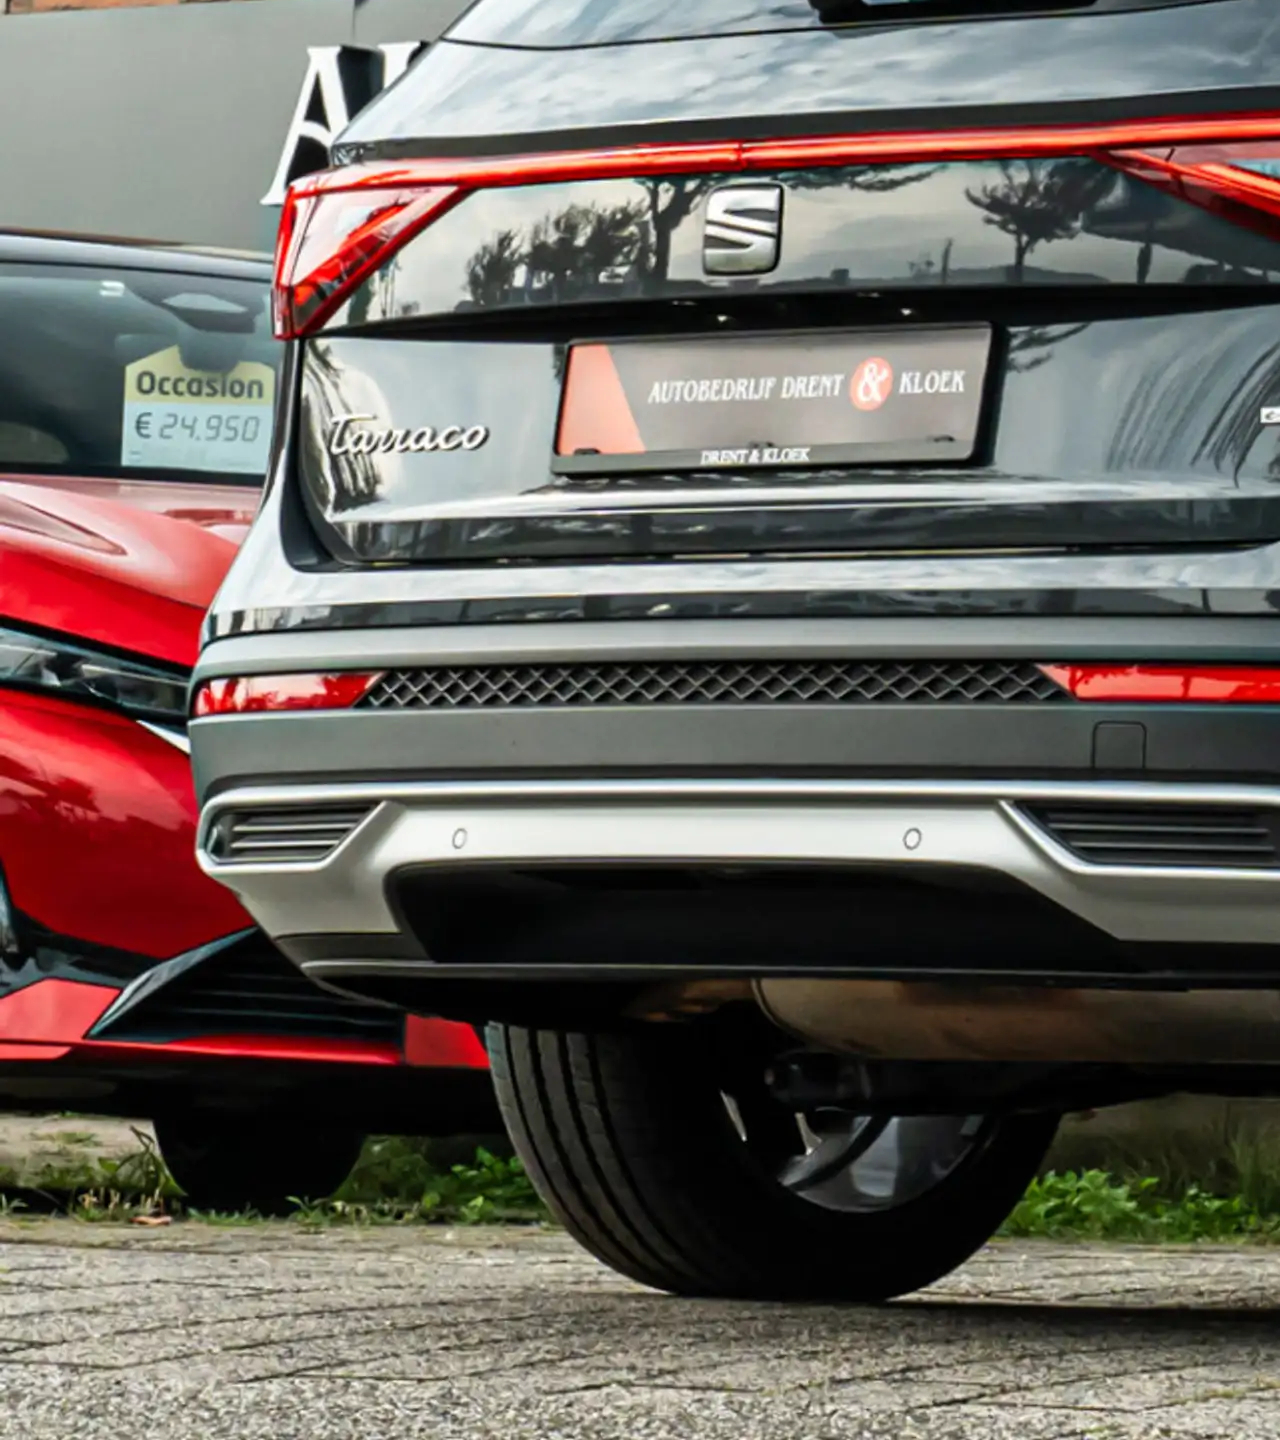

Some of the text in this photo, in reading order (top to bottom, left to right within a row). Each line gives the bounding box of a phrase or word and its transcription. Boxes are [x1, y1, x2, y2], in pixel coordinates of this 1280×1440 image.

[136, 370, 264, 399] Occasion
[647, 362, 967, 405] AUTOBEDRIJF DRENT & KLOEK
[158, 412, 261, 443] 24.950
[330, 413, 490, 455] Tarraco
[700, 449, 749, 466] DRENT
[761, 446, 811, 463] KLOEK
